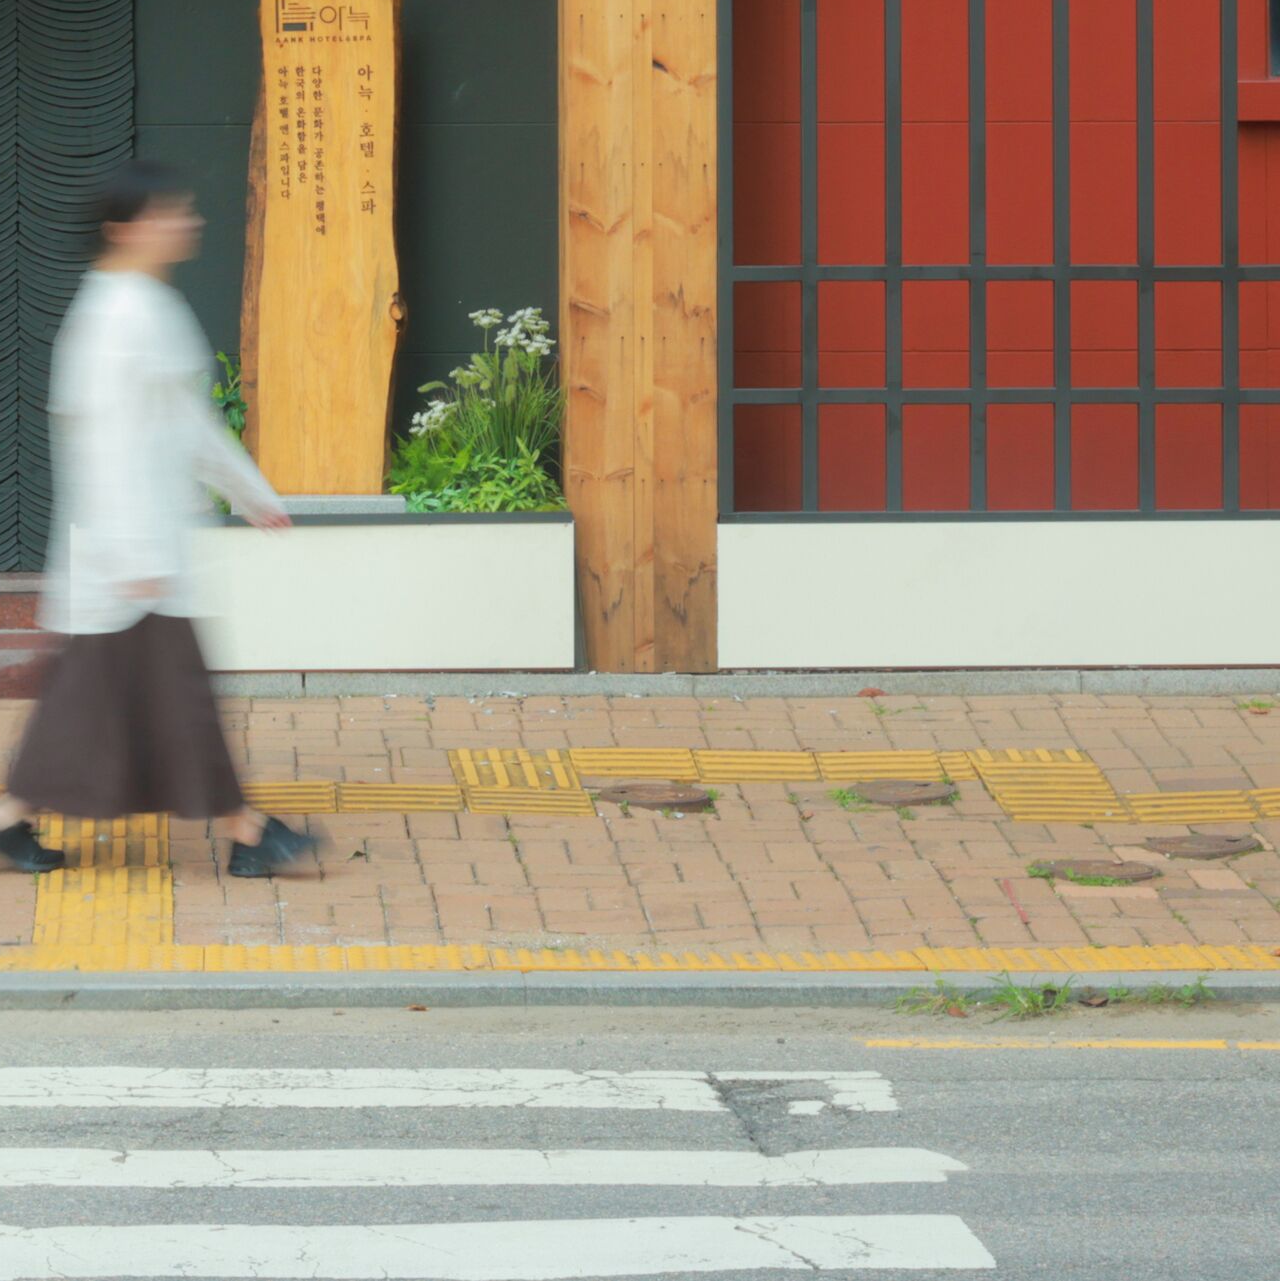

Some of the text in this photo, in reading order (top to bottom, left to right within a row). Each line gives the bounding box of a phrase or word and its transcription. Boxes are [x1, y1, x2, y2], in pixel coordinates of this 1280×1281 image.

[275, 35, 305, 44] AANK
[295, 65, 306, 102] 한국의
[311, 65, 323, 101] 다양한
[278, 95, 290, 119] 호텔
[313, 106, 325, 143] 문화가
[357, 64, 377, 216] 아늑 호텔 스파
[279, 141, 291, 201] 스파입니다
[297, 159, 309, 184] 담은
